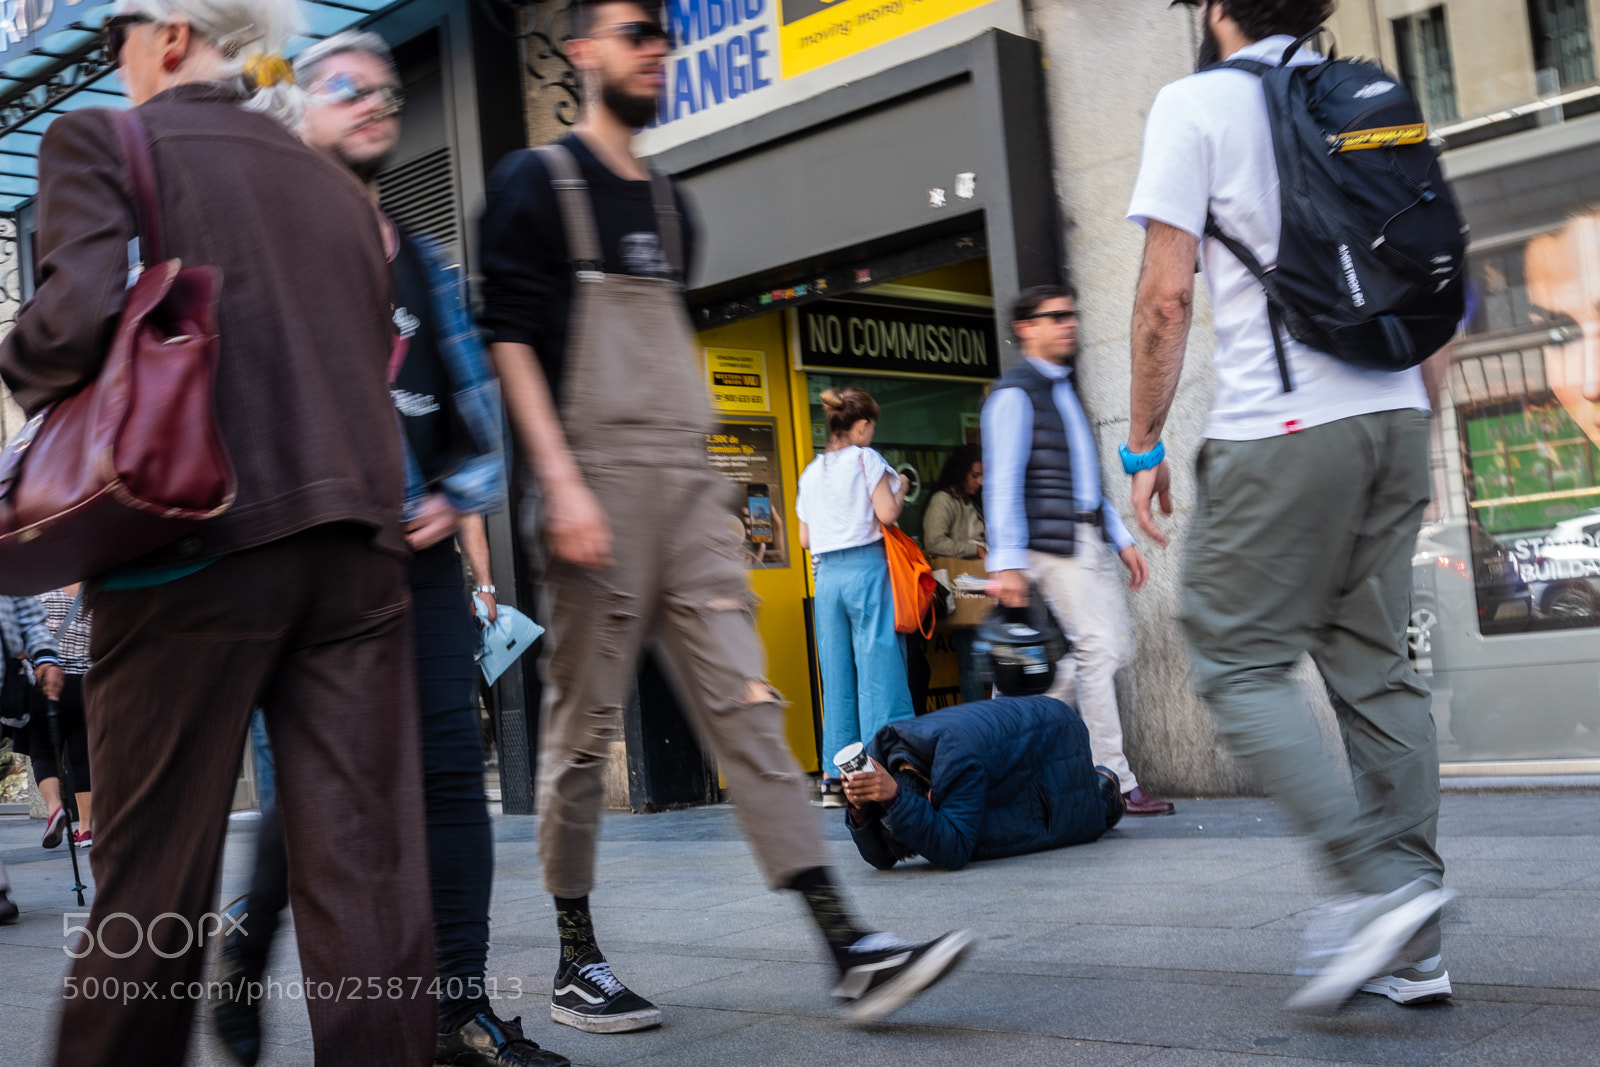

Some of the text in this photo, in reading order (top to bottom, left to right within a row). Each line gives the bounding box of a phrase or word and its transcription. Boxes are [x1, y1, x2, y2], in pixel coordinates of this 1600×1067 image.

[800, 20, 852, 48] moving
[633, 24, 773, 134] ANGE
[807, 312, 988, 366] NO COMMISSION
